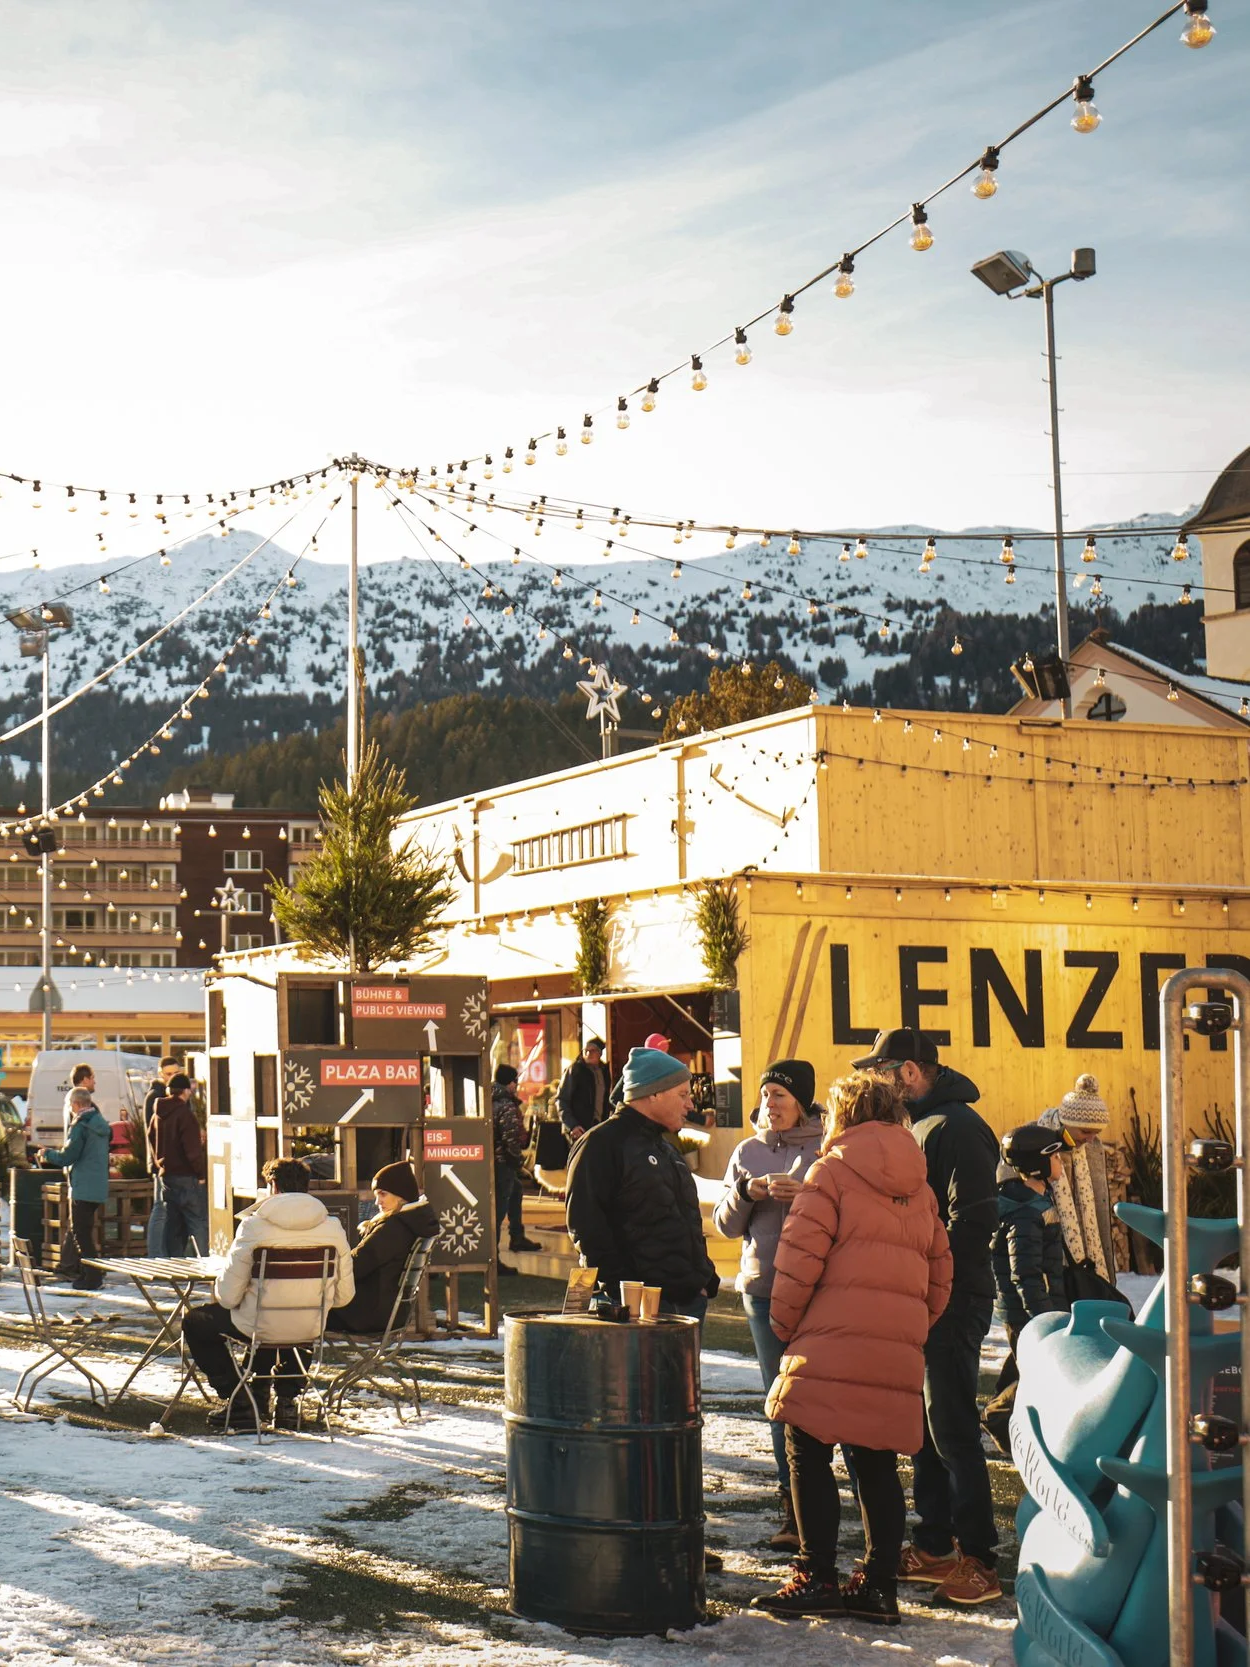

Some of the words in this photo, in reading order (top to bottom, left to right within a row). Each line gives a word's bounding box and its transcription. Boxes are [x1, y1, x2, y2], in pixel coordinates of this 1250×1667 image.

[355, 988, 392, 999] BÜHNE
[395, 990, 403, 999] &
[355, 1005, 394, 1016] PUBLIC
[396, 1005, 444, 1016] VIEWING
[325, 1064, 381, 1080] PLAZA
[385, 1064, 418, 1080] BAR
[427, 1132, 446, 1143] EIS-
[427, 1147, 480, 1158] MINIGOLF
